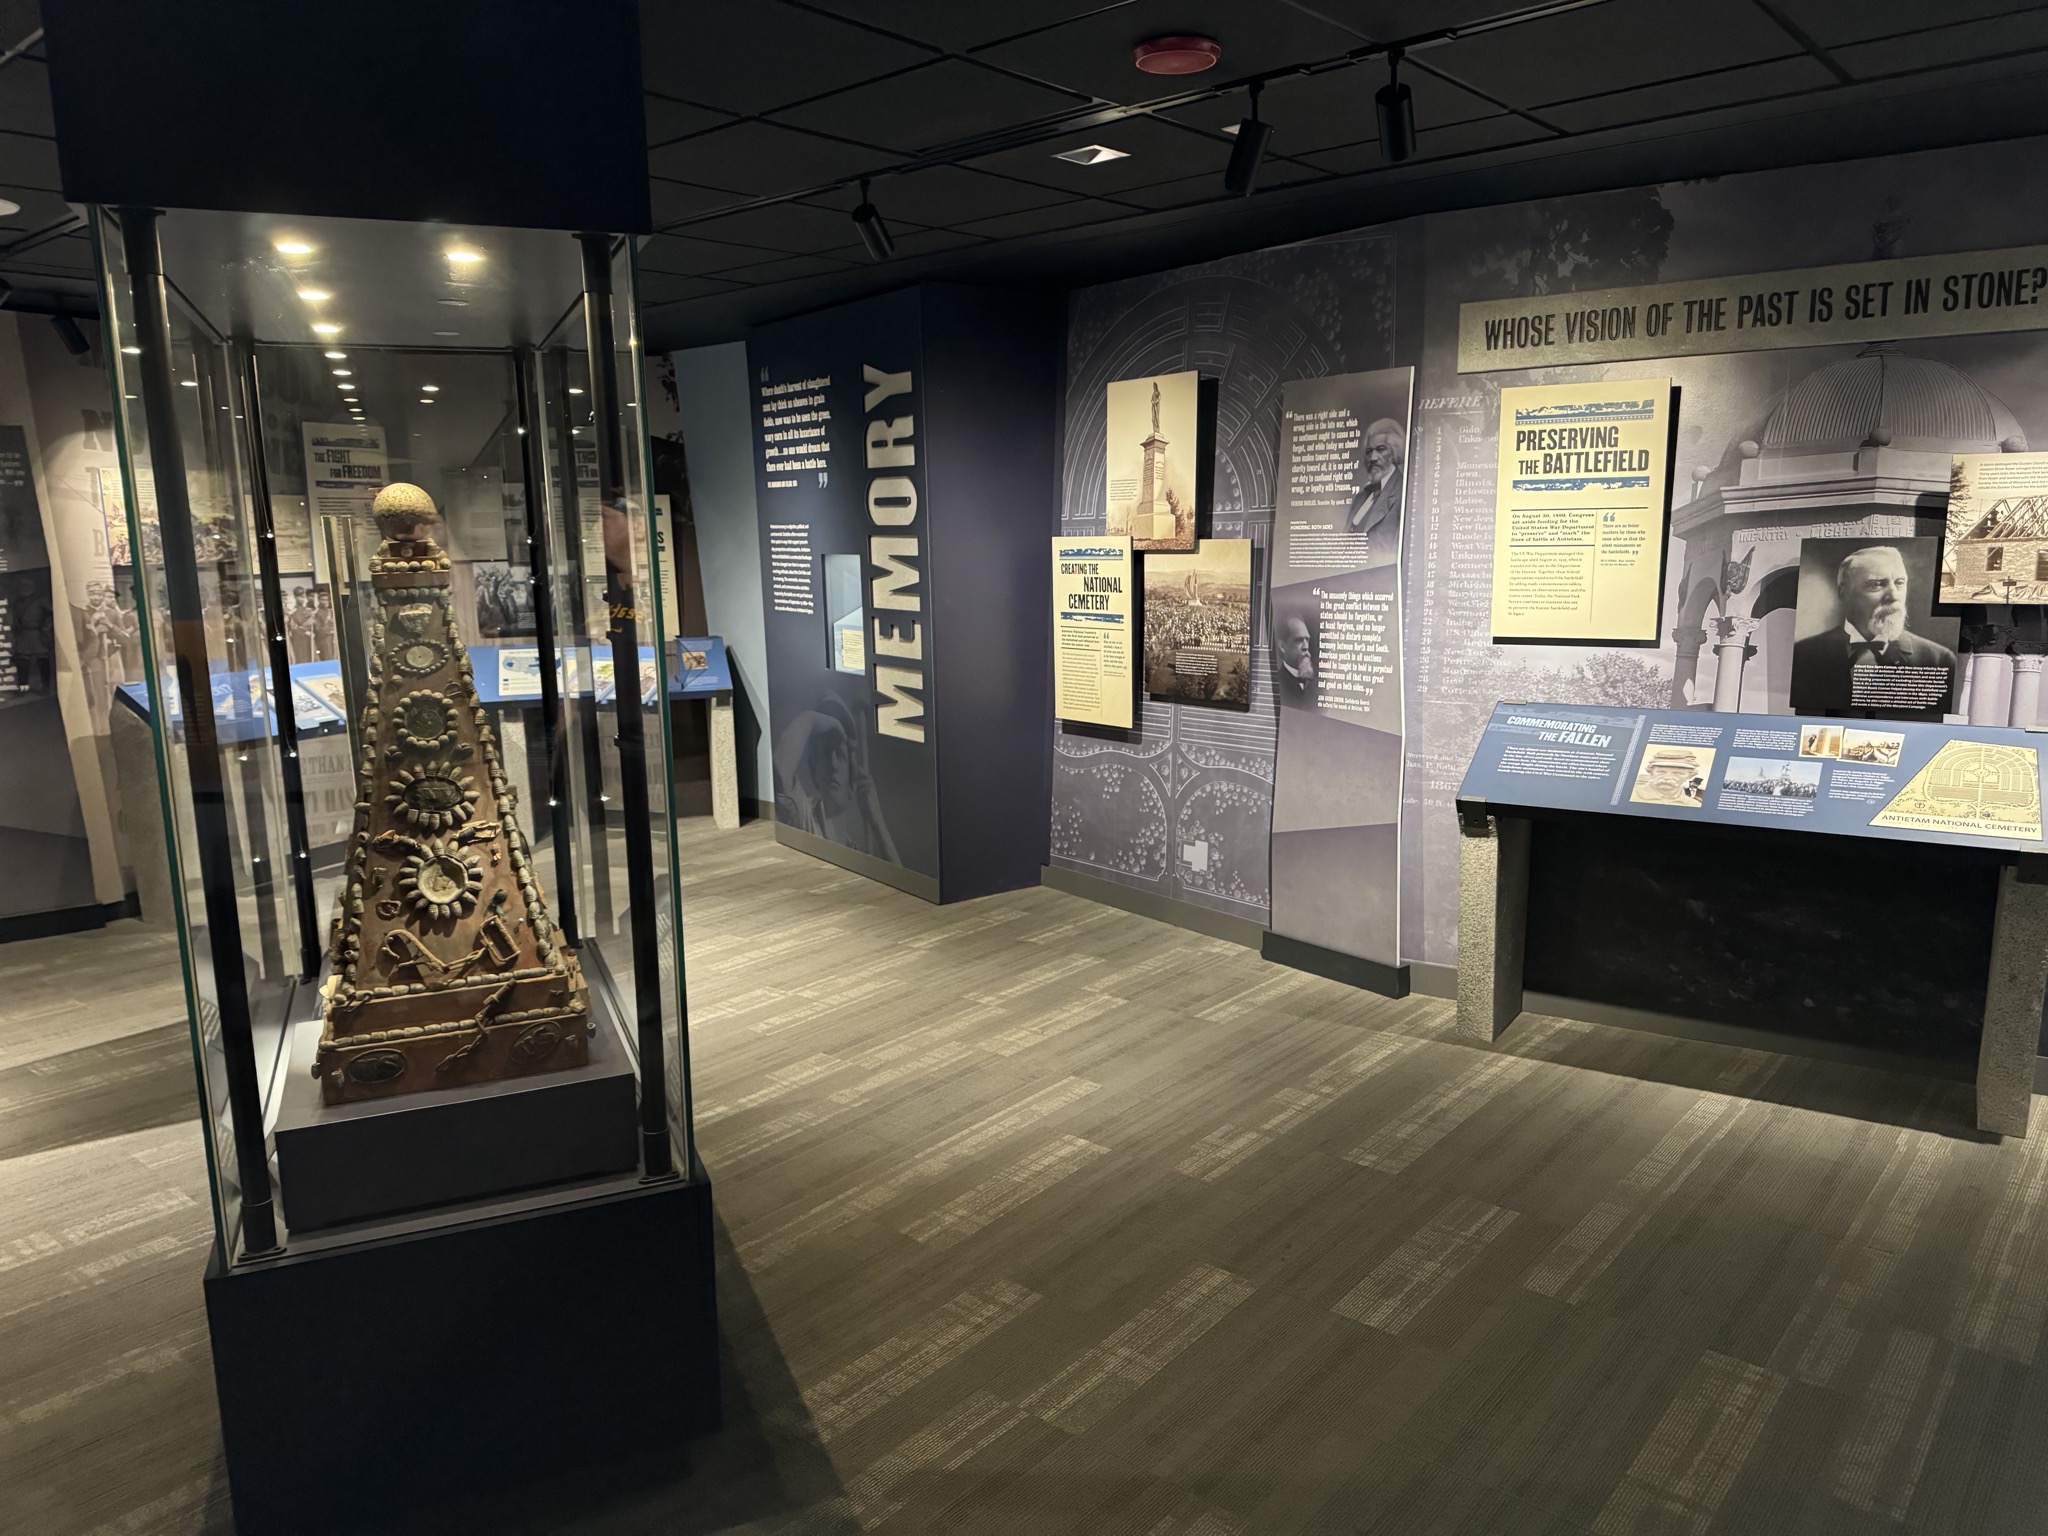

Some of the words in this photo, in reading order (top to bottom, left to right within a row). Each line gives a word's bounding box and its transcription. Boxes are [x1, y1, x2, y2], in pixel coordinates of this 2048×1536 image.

[1485, 314, 1555, 350] WHOSE
[1565, 306, 1636, 344] VISION
[1646, 303, 1674, 337] OF
[1683, 297, 1727, 333] THE
[1739, 290, 1799, 329] PAST
[1809, 287, 1833, 323] IS
[1845, 282, 1894, 320] SET
[1904, 278, 1931, 315] IN
[1943, 267, 2047, 312] STONE?
[1516, 426, 1618, 451] PRESERVING
[326, 449, 350, 463] FIGHT
[1518, 460, 1540, 475] THE
[1543, 450, 1649, 474] BATTLEFIELD
[342, 465, 381, 478] FREEDOM
[862, 364, 925, 743] MEMORY
[1061, 563, 1087, 574] CREATING
[1088, 564, 1099, 574] THE
[1084, 576, 1122, 593] NATIONAL
[1069, 593, 1109, 610] CEMETERY
[1507, 716, 1597, 733] COMMEMORATING
[1538, 732, 1559, 742] THE
[1558, 731, 1612, 748] FALLEN
[1882, 815, 1930, 823] ANTIETAM
[1933, 819, 1982, 828] NATIONAL
[1985, 823, 2037, 833] CEMETERY
